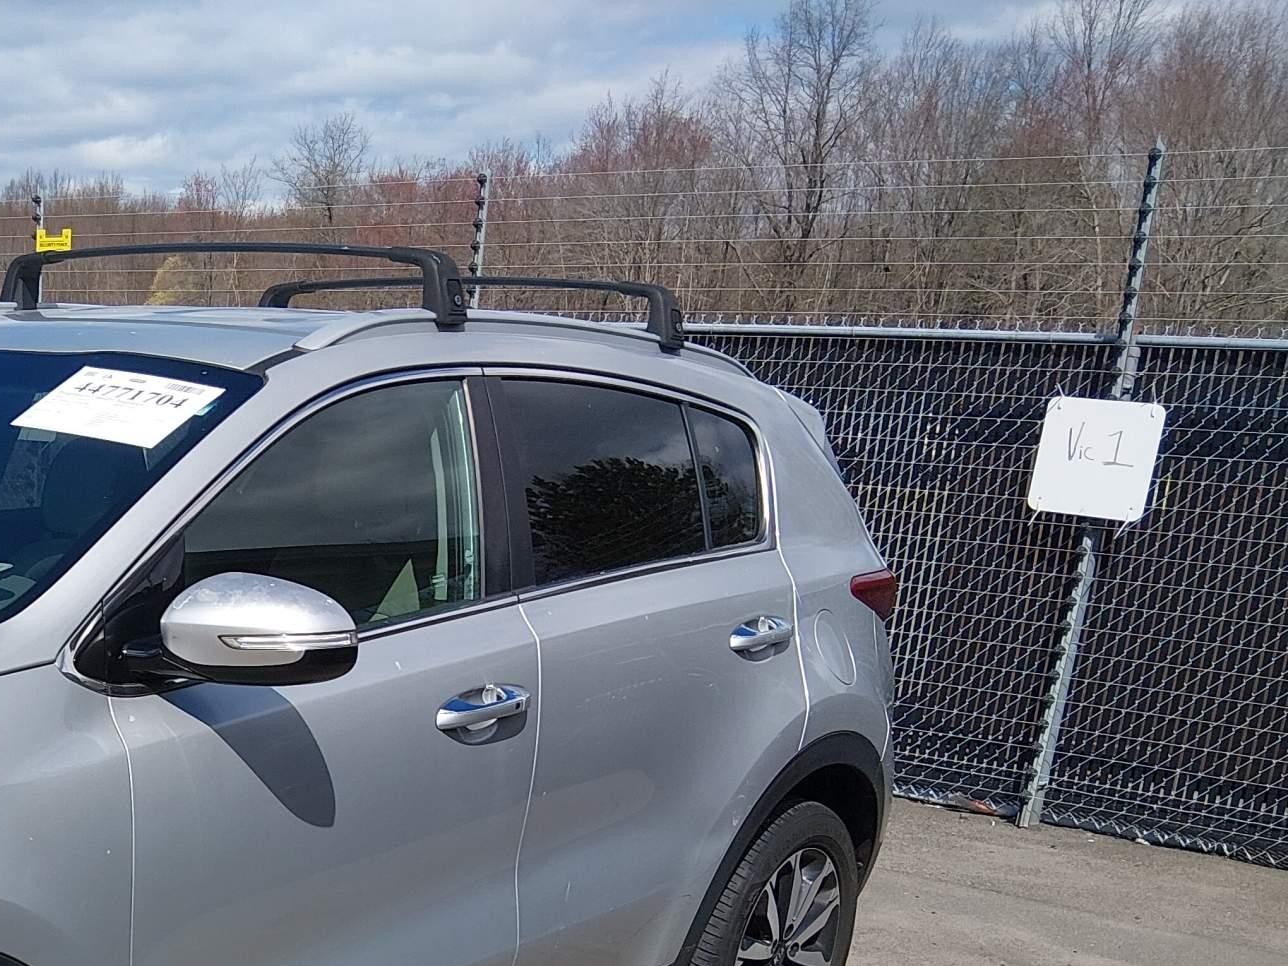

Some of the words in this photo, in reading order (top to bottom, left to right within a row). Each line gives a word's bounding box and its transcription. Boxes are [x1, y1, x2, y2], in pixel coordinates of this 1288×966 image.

[74, 382, 187, 408] 44771704
[1068, 421, 1095, 460] Vic
[1103, 430, 1133, 467] 1
